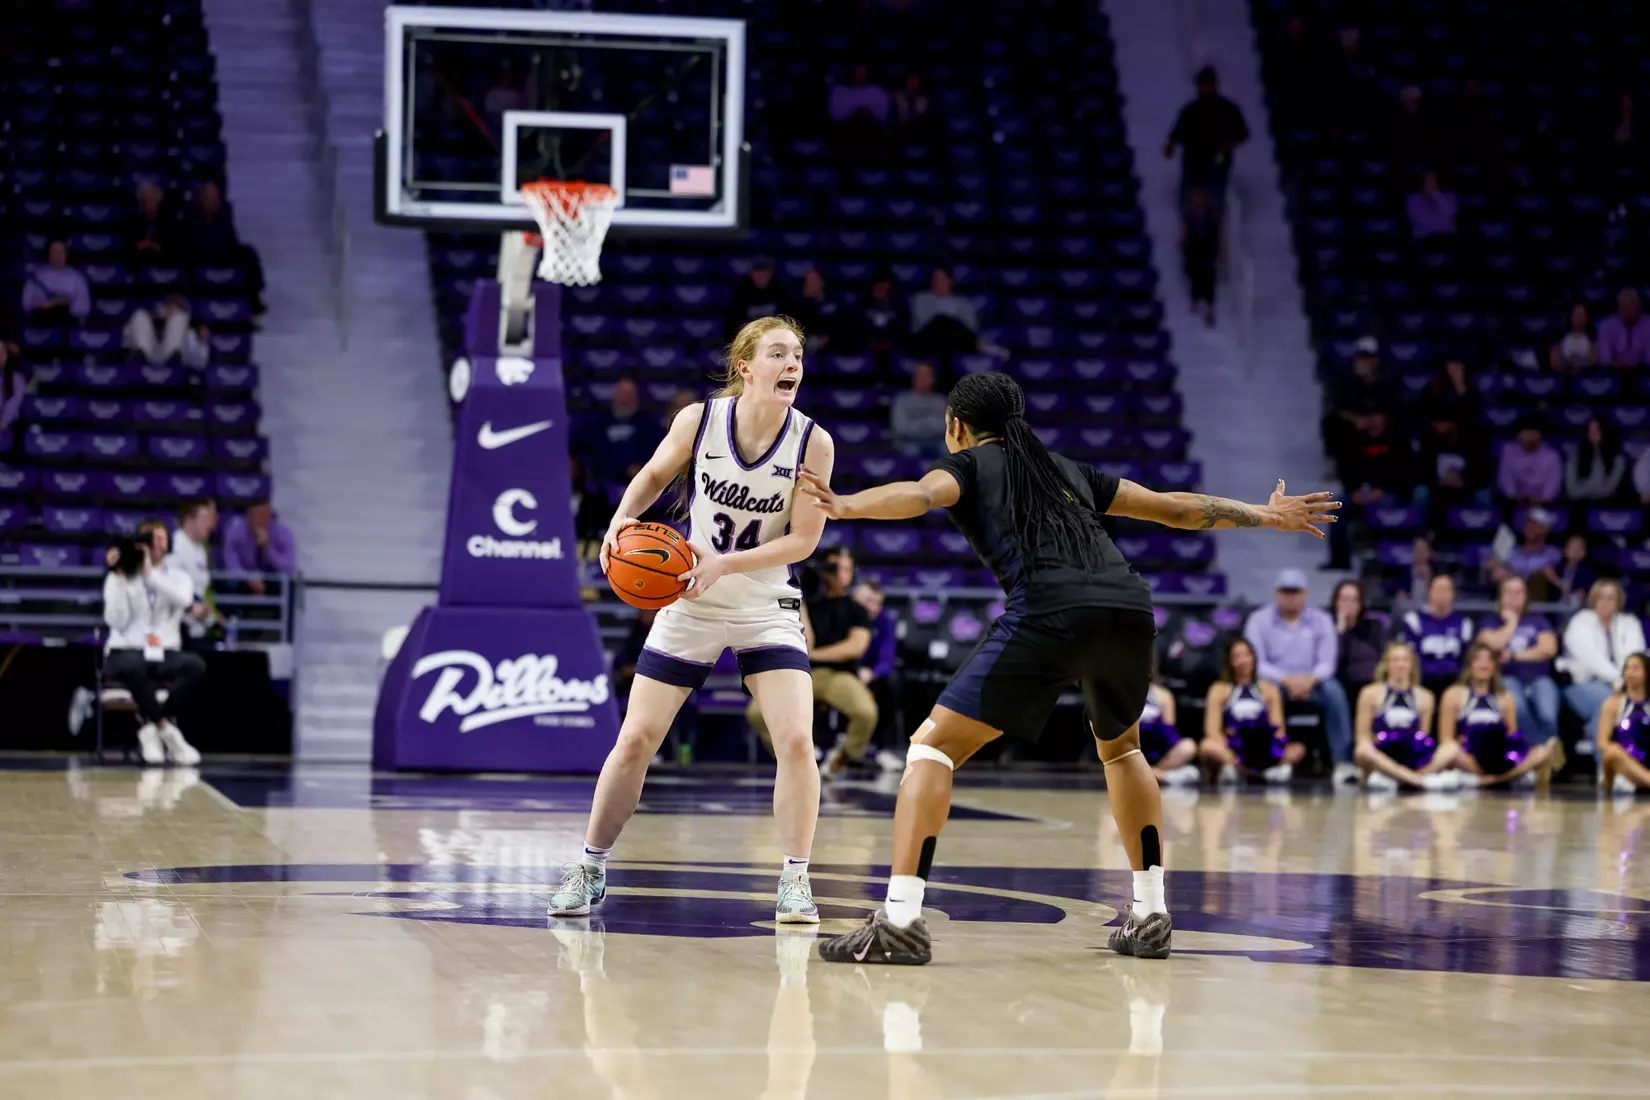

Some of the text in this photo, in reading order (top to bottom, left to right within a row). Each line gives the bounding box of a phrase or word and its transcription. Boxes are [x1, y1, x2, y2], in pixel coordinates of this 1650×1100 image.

[493, 487, 538, 537] C
[701, 472, 785, 513] Wildcats
[467, 535, 563, 559] Channel
[634, 524, 680, 543] ELITE
[711, 512, 762, 555] 34
[412, 650, 609, 725] Dillons
